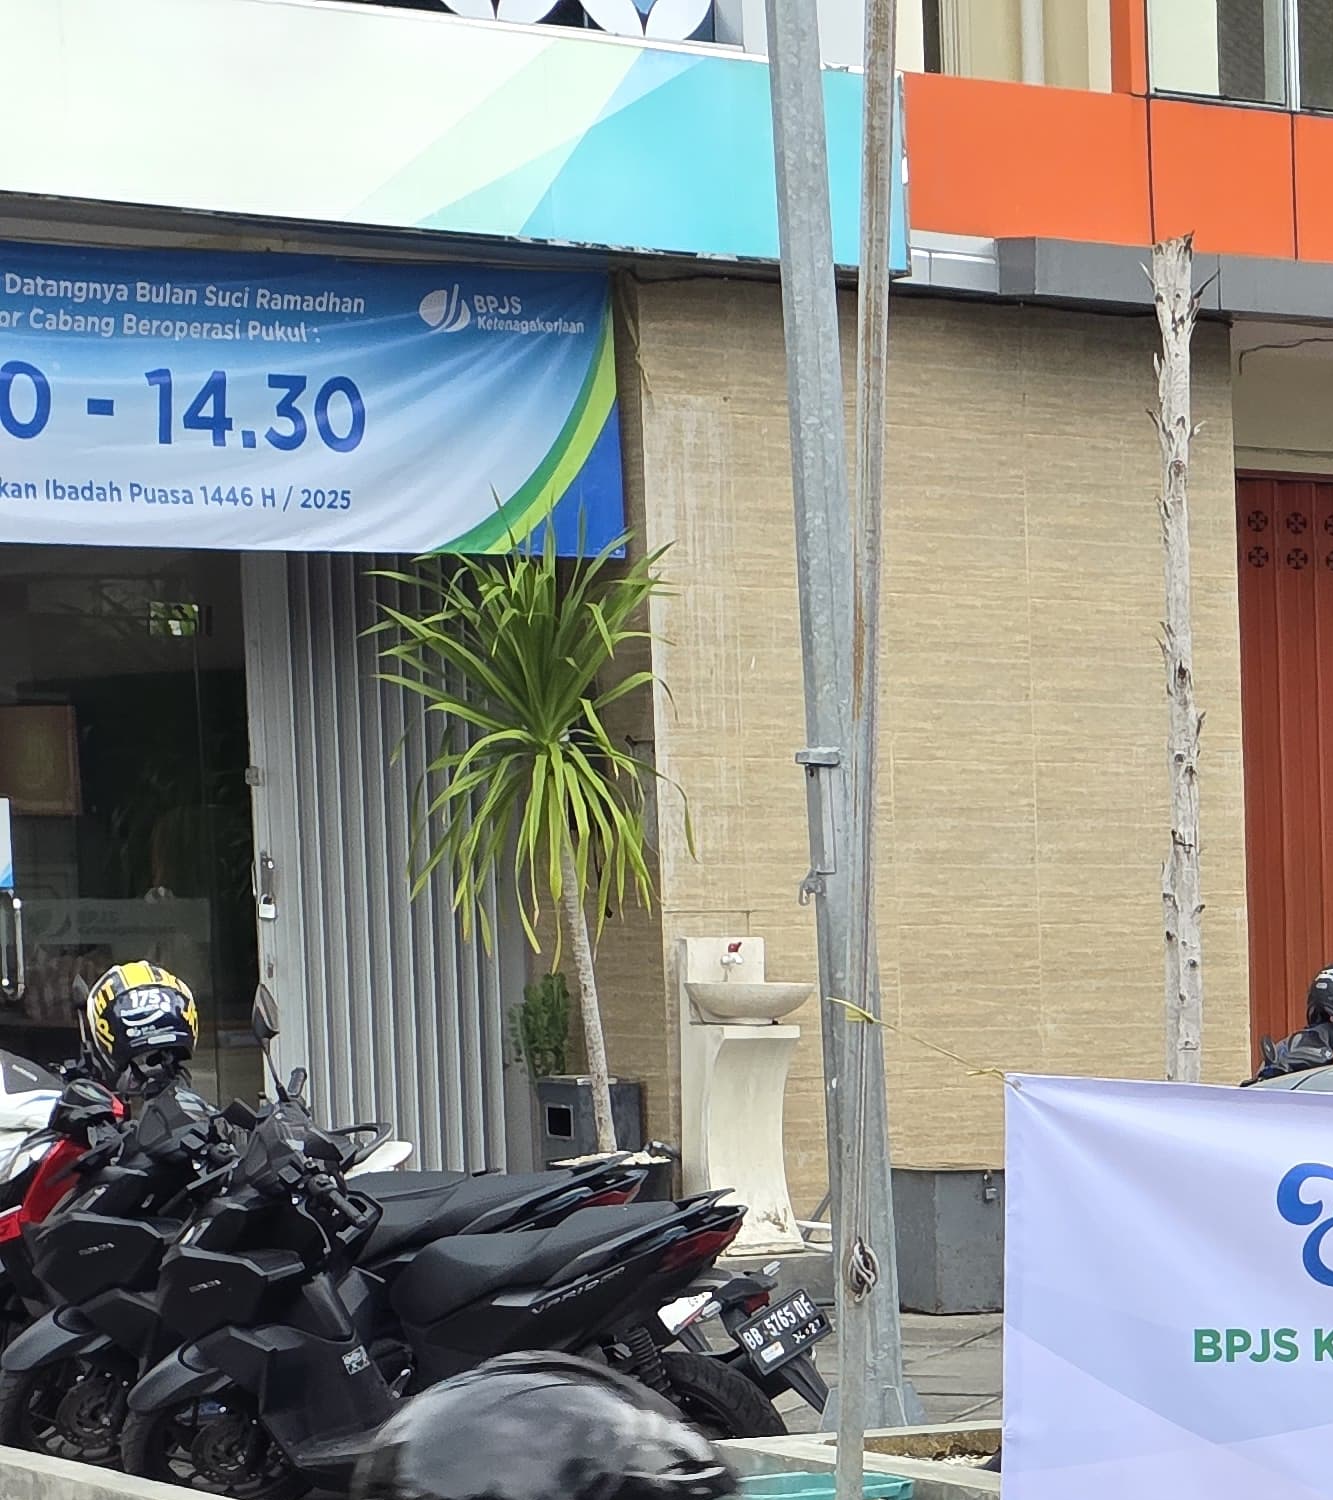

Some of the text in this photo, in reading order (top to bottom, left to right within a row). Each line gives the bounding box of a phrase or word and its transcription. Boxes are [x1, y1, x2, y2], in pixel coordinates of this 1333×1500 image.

[5, 273, 366, 314] Datangnya Bulan Suci Ramadhan
[29, 308, 115, 337] Cabang
[122, 313, 241, 341] Beroperasi
[247, 320, 308, 343] Pukul
[473, 295, 585, 336] BPJS Ketenagakerjaan
[145, 368, 366, 453] 14.30
[45, 479, 122, 502] Ibadah
[129, 482, 195, 505] Puasa
[199, 485, 252, 507] 1446
[261, 488, 276, 509] H
[300, 488, 352, 510] 2025
[129, 988, 160, 1009] 175
[1193, 1328, 1299, 1363] BPJS
